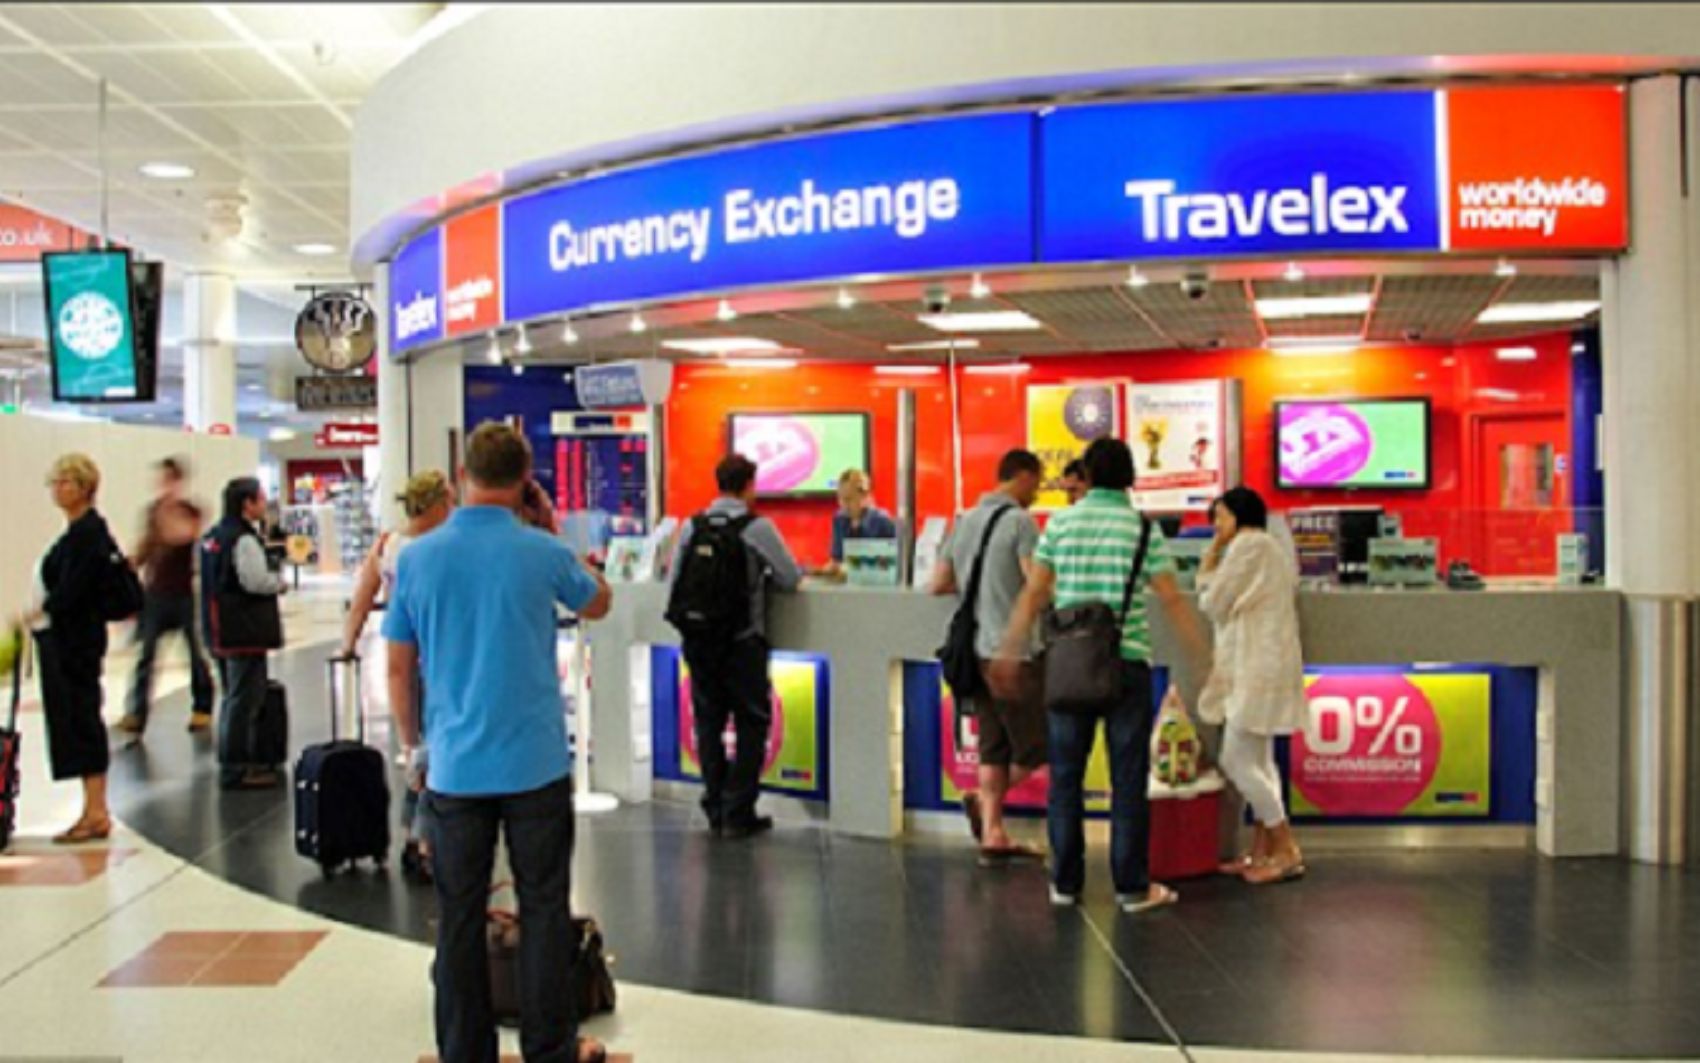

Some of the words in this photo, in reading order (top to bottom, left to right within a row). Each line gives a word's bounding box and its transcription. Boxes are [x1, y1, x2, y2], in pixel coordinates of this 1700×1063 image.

[1125, 173, 1409, 240] Travelex
[1458, 177, 1608, 207] worldwide
[0, 221, 52, 246] o.uk
[549, 220, 711, 272] Currency
[724, 178, 959, 242] Exchange
[1459, 207, 1558, 236] money
[1304, 695, 1422, 755] 0%
[1303, 757, 1422, 774] COMMISSION
